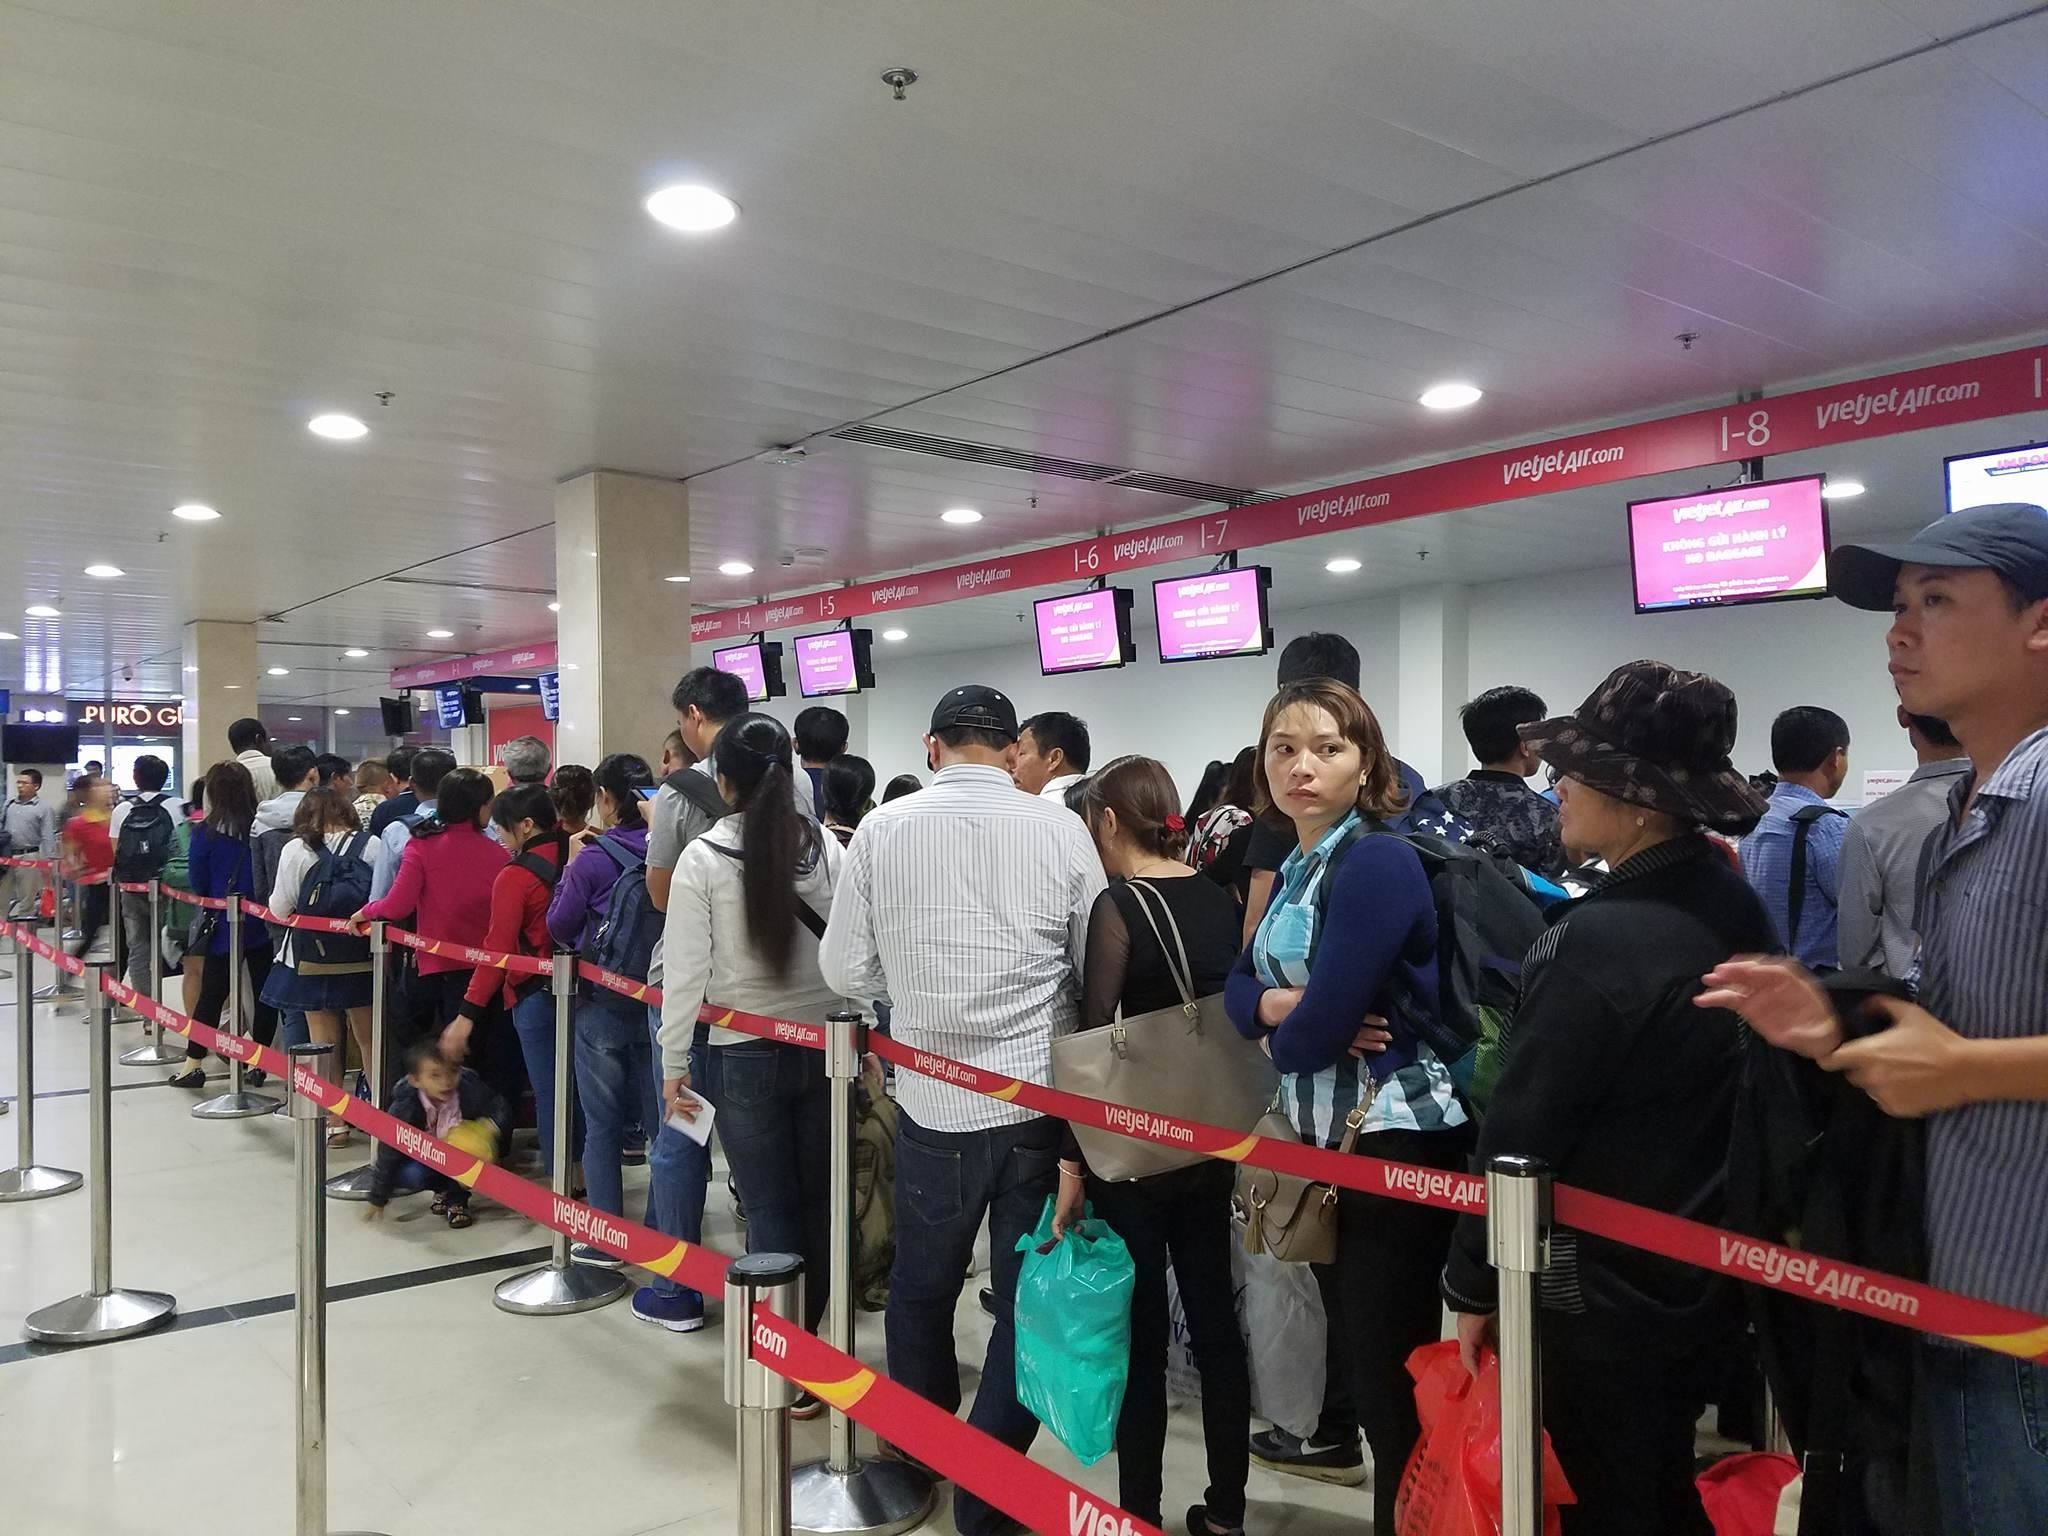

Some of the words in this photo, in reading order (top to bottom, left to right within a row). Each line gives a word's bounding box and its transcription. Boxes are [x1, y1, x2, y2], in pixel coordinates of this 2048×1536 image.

[1721, 410, 1770, 451] I-8
[1201, 519, 1228, 548] I-7
[1074, 545, 1099, 572] I-6
